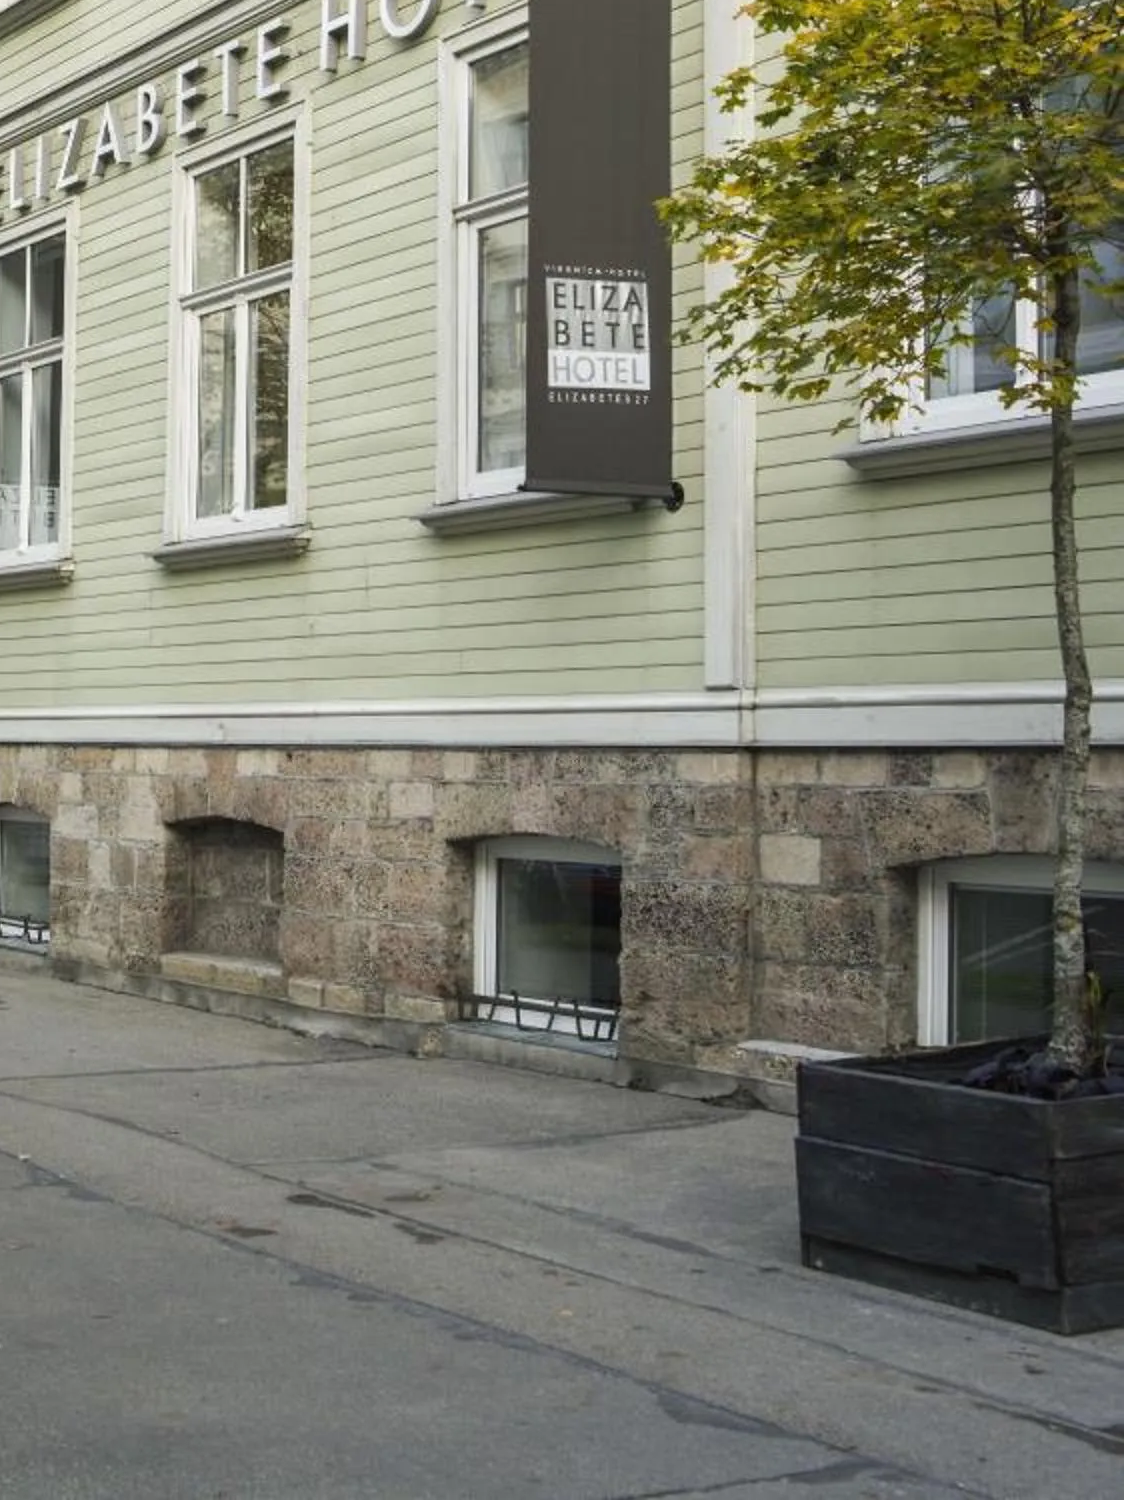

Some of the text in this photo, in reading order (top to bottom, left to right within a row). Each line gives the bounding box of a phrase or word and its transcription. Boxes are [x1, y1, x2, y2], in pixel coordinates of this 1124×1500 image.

[553, 281, 643, 312] ELIZA
[554, 319, 645, 350] BETE
[553, 355, 645, 384] HOTEL
